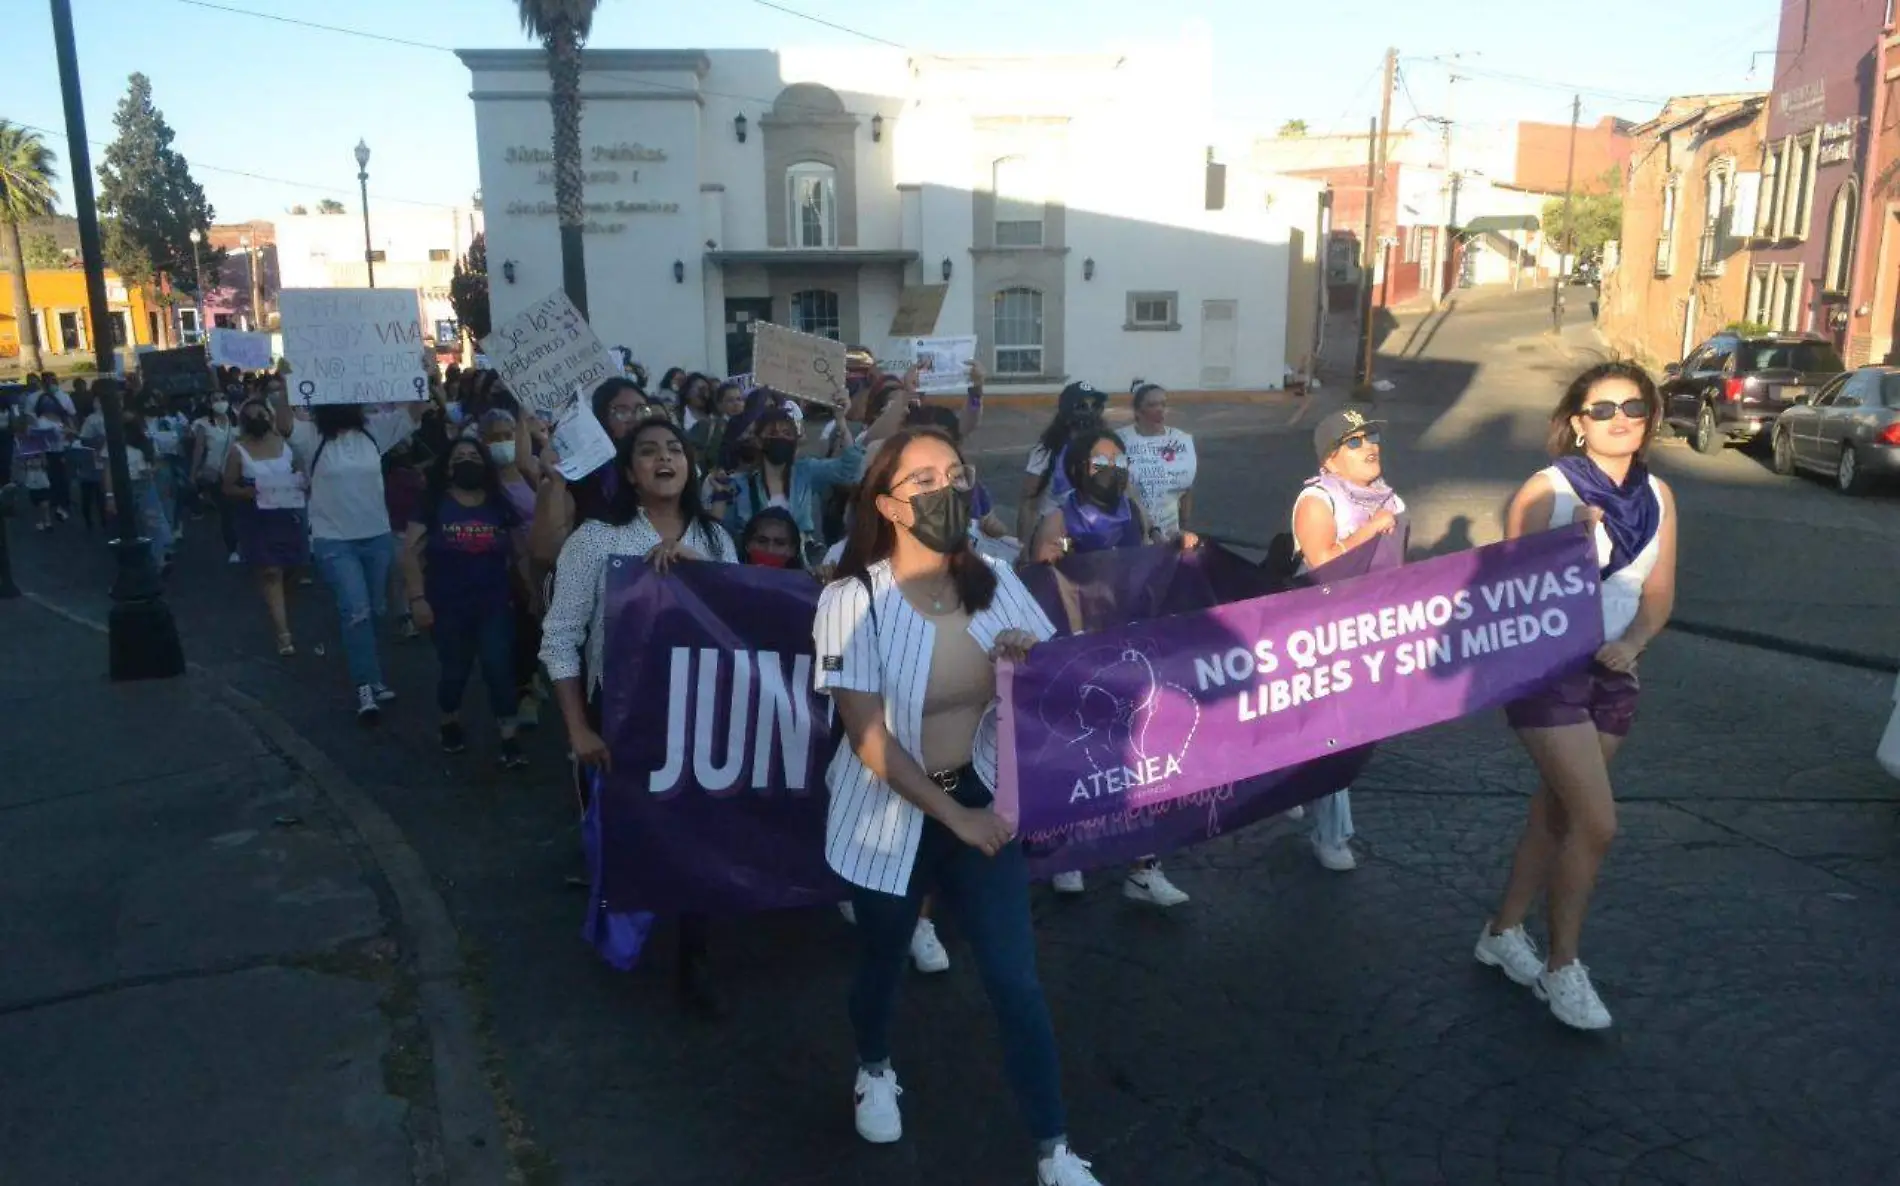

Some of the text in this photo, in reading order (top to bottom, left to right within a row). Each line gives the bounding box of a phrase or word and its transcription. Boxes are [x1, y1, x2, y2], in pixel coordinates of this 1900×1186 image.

[375, 319, 422, 345] VIVA
[1194, 564, 1597, 692] NOS QUEREMOS VIVAS,
[1237, 606, 1569, 723] LIBRES Y SIN MIEDO
[1068, 752, 1182, 804] ATENEA
